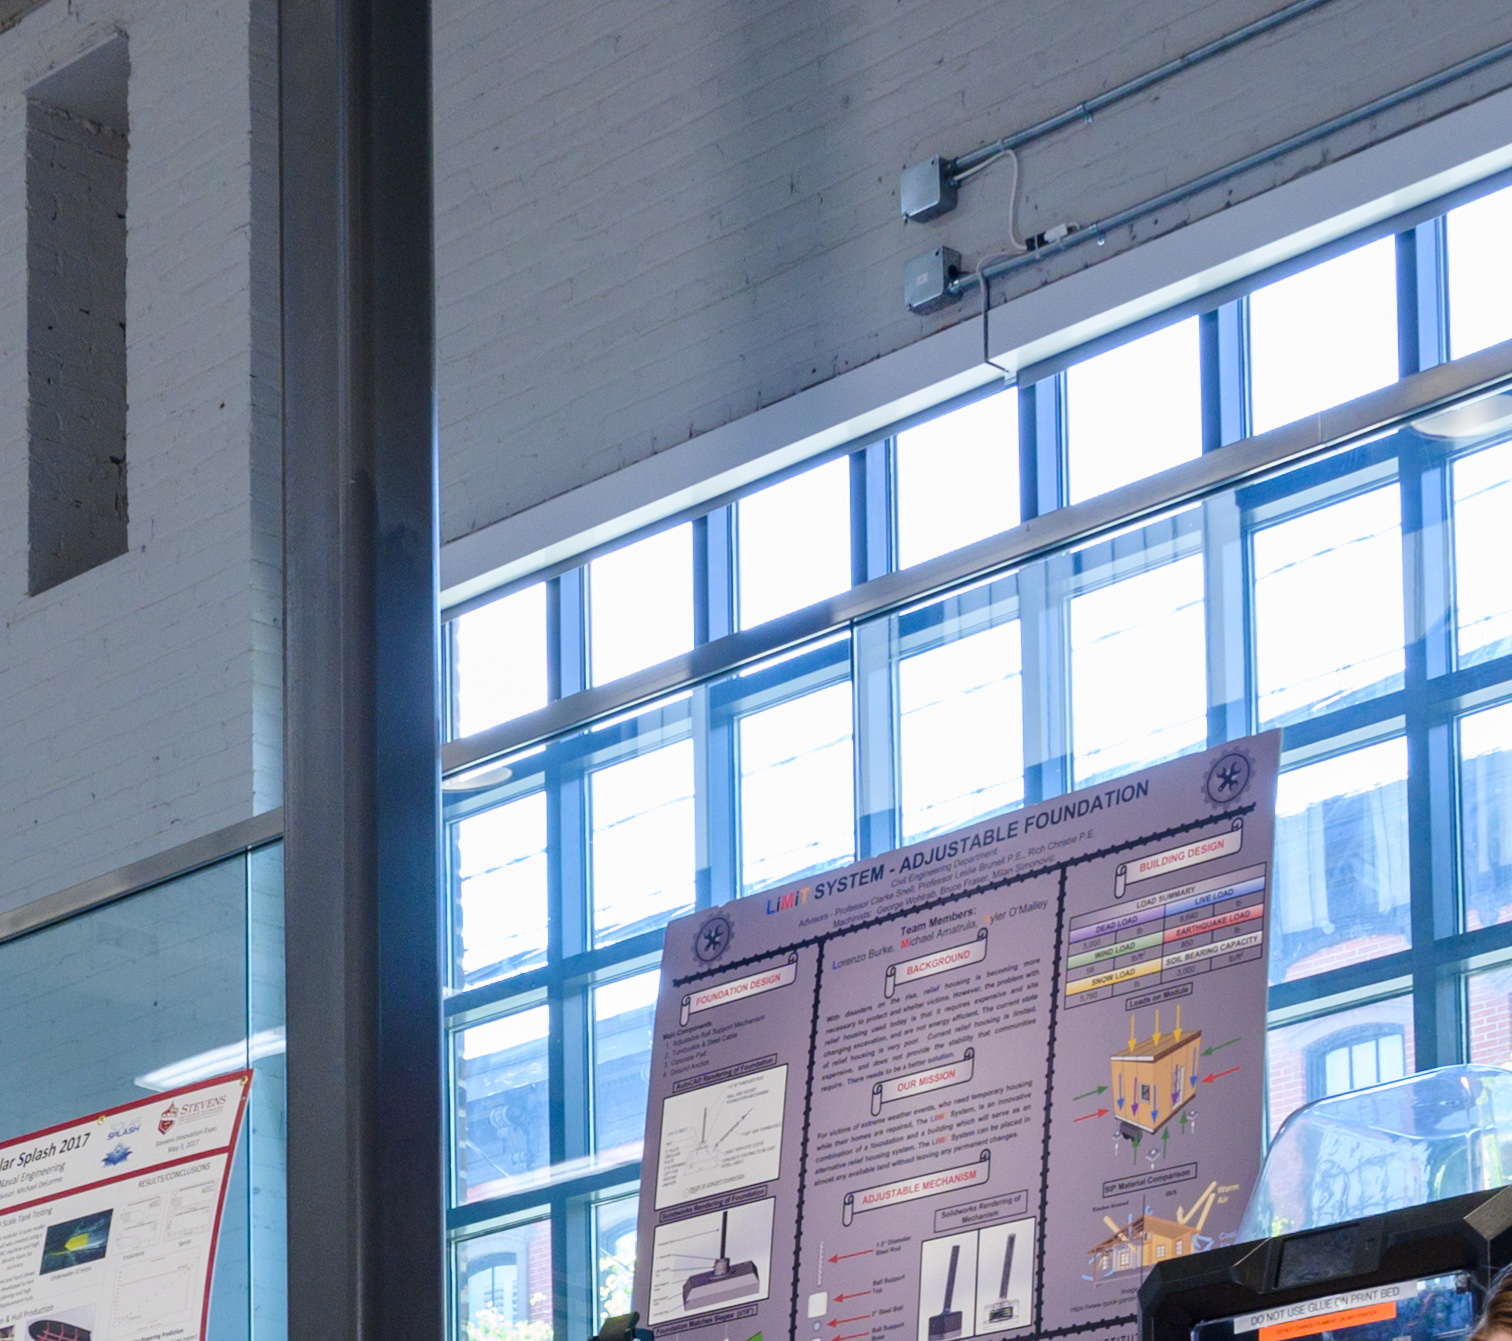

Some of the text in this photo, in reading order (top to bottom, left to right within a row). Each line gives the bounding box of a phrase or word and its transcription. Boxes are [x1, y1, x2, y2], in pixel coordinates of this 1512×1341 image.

[766, 886, 811, 914] LiMiT
[814, 864, 884, 899] SYSTEM
[900, 821, 1017, 872] ADJUSTABLE
[1024, 781, 1148, 832] FOUNDATION
[1139, 840, 1224, 872] BUILDING DESIGN
[1136, 886, 1195, 908] LOAD SUMMARY
[1194, 888, 1233, 905] LIVE LOAD
[901, 908, 975, 935] Team Members:
[1095, 916, 1137, 933] DEAD LOAD
[900, 931, 934, 948] Michael
[1094, 942, 1135, 959] WIND LOAD
[1166, 936, 1258, 966] SOIL BEARING CAPACITY
[906, 950, 970, 975] BACKGROUND
[696, 973, 781, 1005] FOUNDATION DESIGN
[1091, 968, 1135, 986] SNOW LOAD
[897, 1069, 955, 1091] OUR MISSION
[180, 1095, 226, 1115] STEVENS
[17, 1143, 56, 1167] Splash
[59, 1132, 90, 1153] 2017
[20, 1162, 65, 1182] Engineering
[138, 1162, 210, 1187] RESULTS/CONCLUSIONS
[862, 1170, 976, 1204] ADJUSTABLE MECHANISM
[1250, 1314, 1264, 1325] DO
[1266, 1309, 1285, 1320] NOT
[1287, 1305, 1305, 1317] USE
[1307, 1299, 1332, 1312] GLUE
[1350, 1290, 1378, 1303] PRINT
[1380, 1286, 1400, 1298] BED
